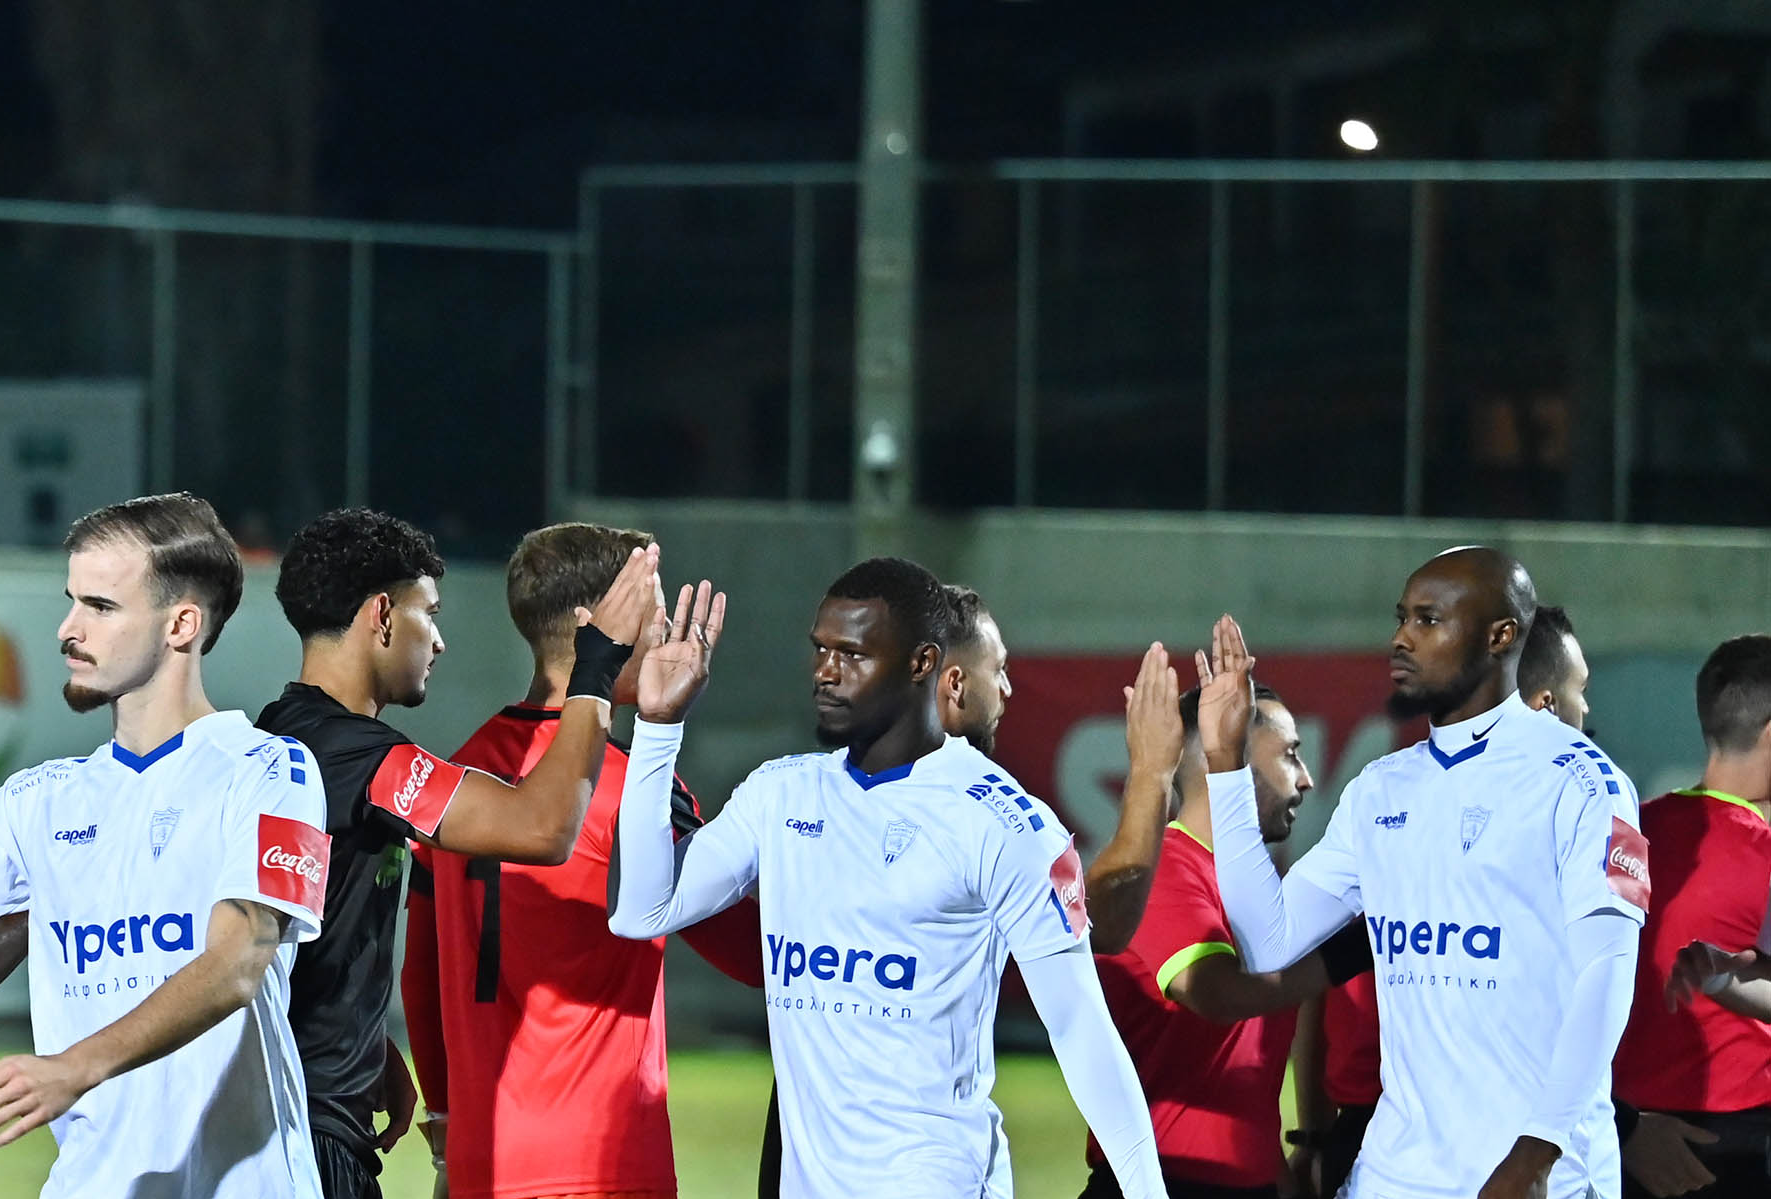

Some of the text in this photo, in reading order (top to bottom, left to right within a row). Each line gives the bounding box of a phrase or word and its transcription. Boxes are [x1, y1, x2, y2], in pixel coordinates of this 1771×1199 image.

[393, 752, 436, 817] Coca-Cola
[1570, 757, 1598, 798] seven
[54, 824, 98, 843] capelli
[785, 818, 825, 834] capelli
[987, 793, 1026, 835] seven
[261, 845, 325, 885] Coca-Cola
[49, 912, 195, 975] Ypera
[1367, 915, 1501, 965] Ypera
[766, 934, 918, 991] Ypera
